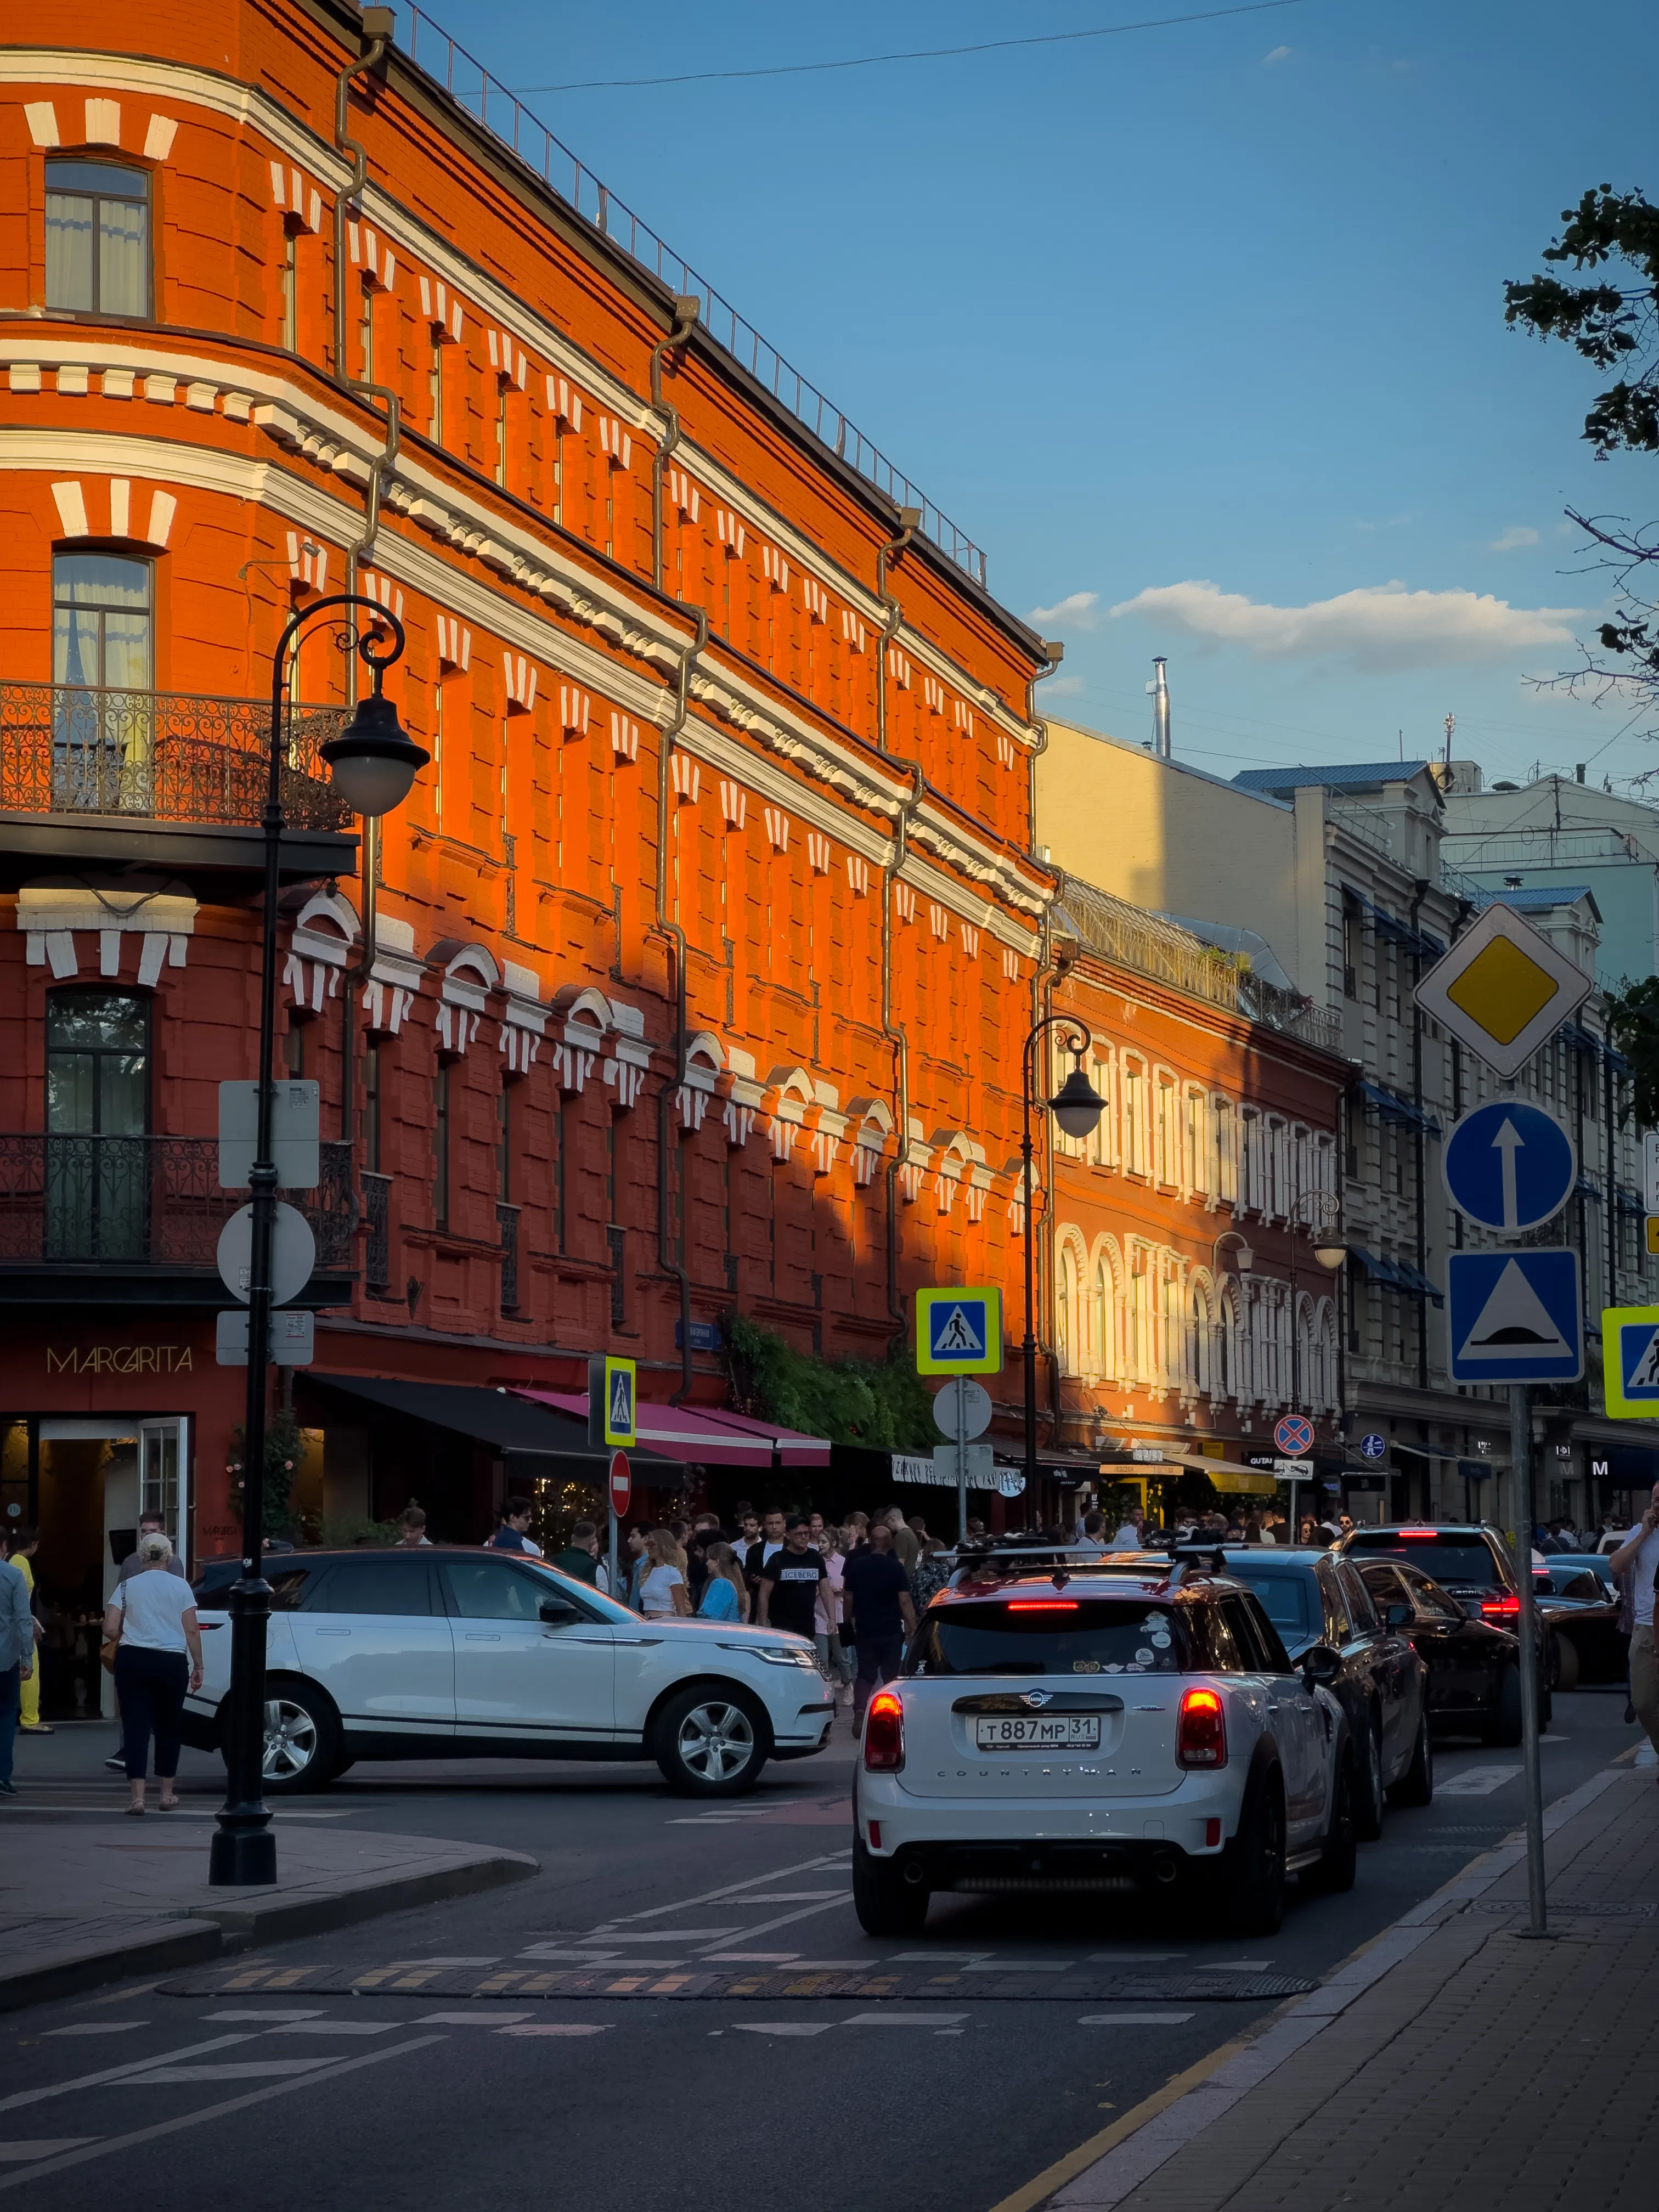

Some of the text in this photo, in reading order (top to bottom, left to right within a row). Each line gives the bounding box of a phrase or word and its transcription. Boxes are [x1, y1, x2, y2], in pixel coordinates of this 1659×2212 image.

[47, 1346, 192, 1373] MARGARITA
[1593, 1462, 1608, 1475] M
[1071, 1719, 1091, 1734] 31
[937, 1768, 1141, 1777] COUNTRYMAN
